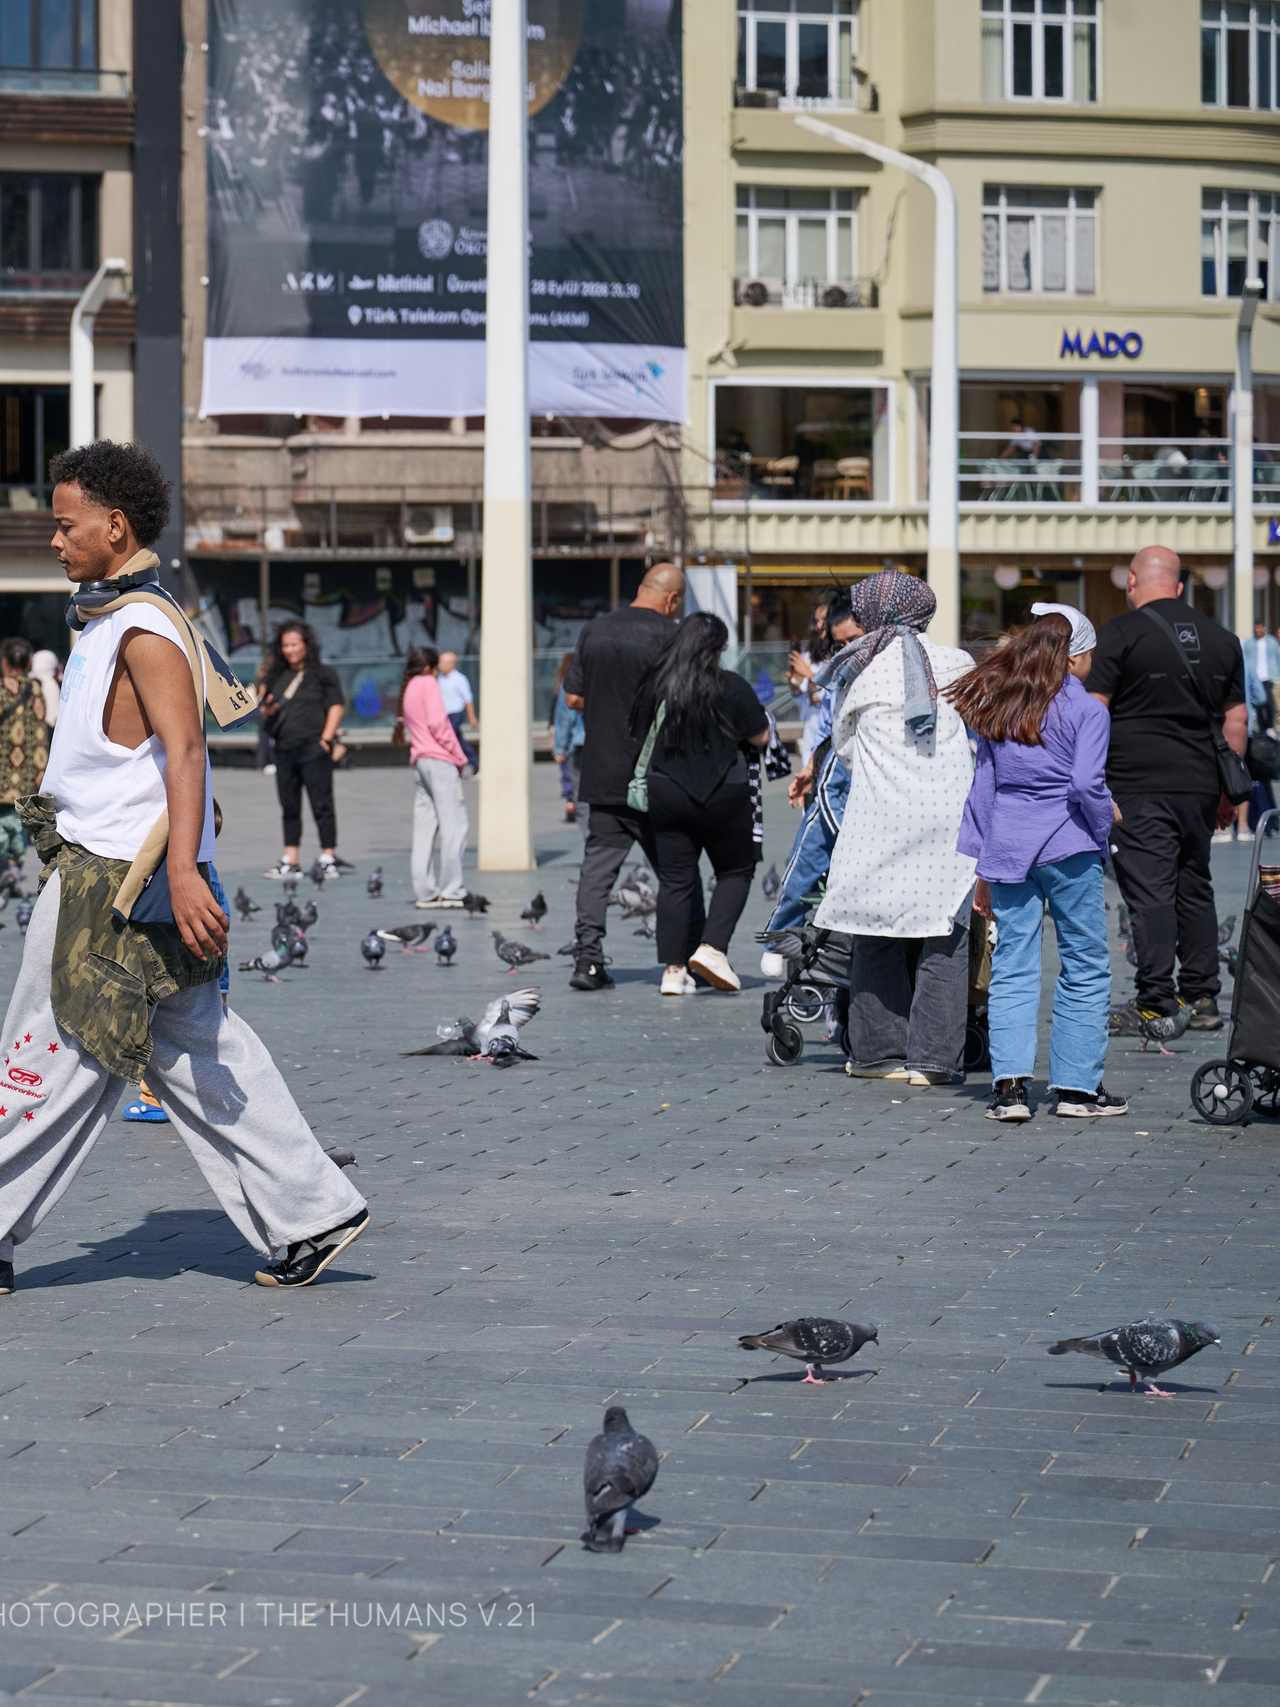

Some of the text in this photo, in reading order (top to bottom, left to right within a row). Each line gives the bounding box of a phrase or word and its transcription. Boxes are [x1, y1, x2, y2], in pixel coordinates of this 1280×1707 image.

[451, 59, 490, 80] Solis
[460, 307, 487, 328] Ope
[1059, 329, 1144, 360] MADO
